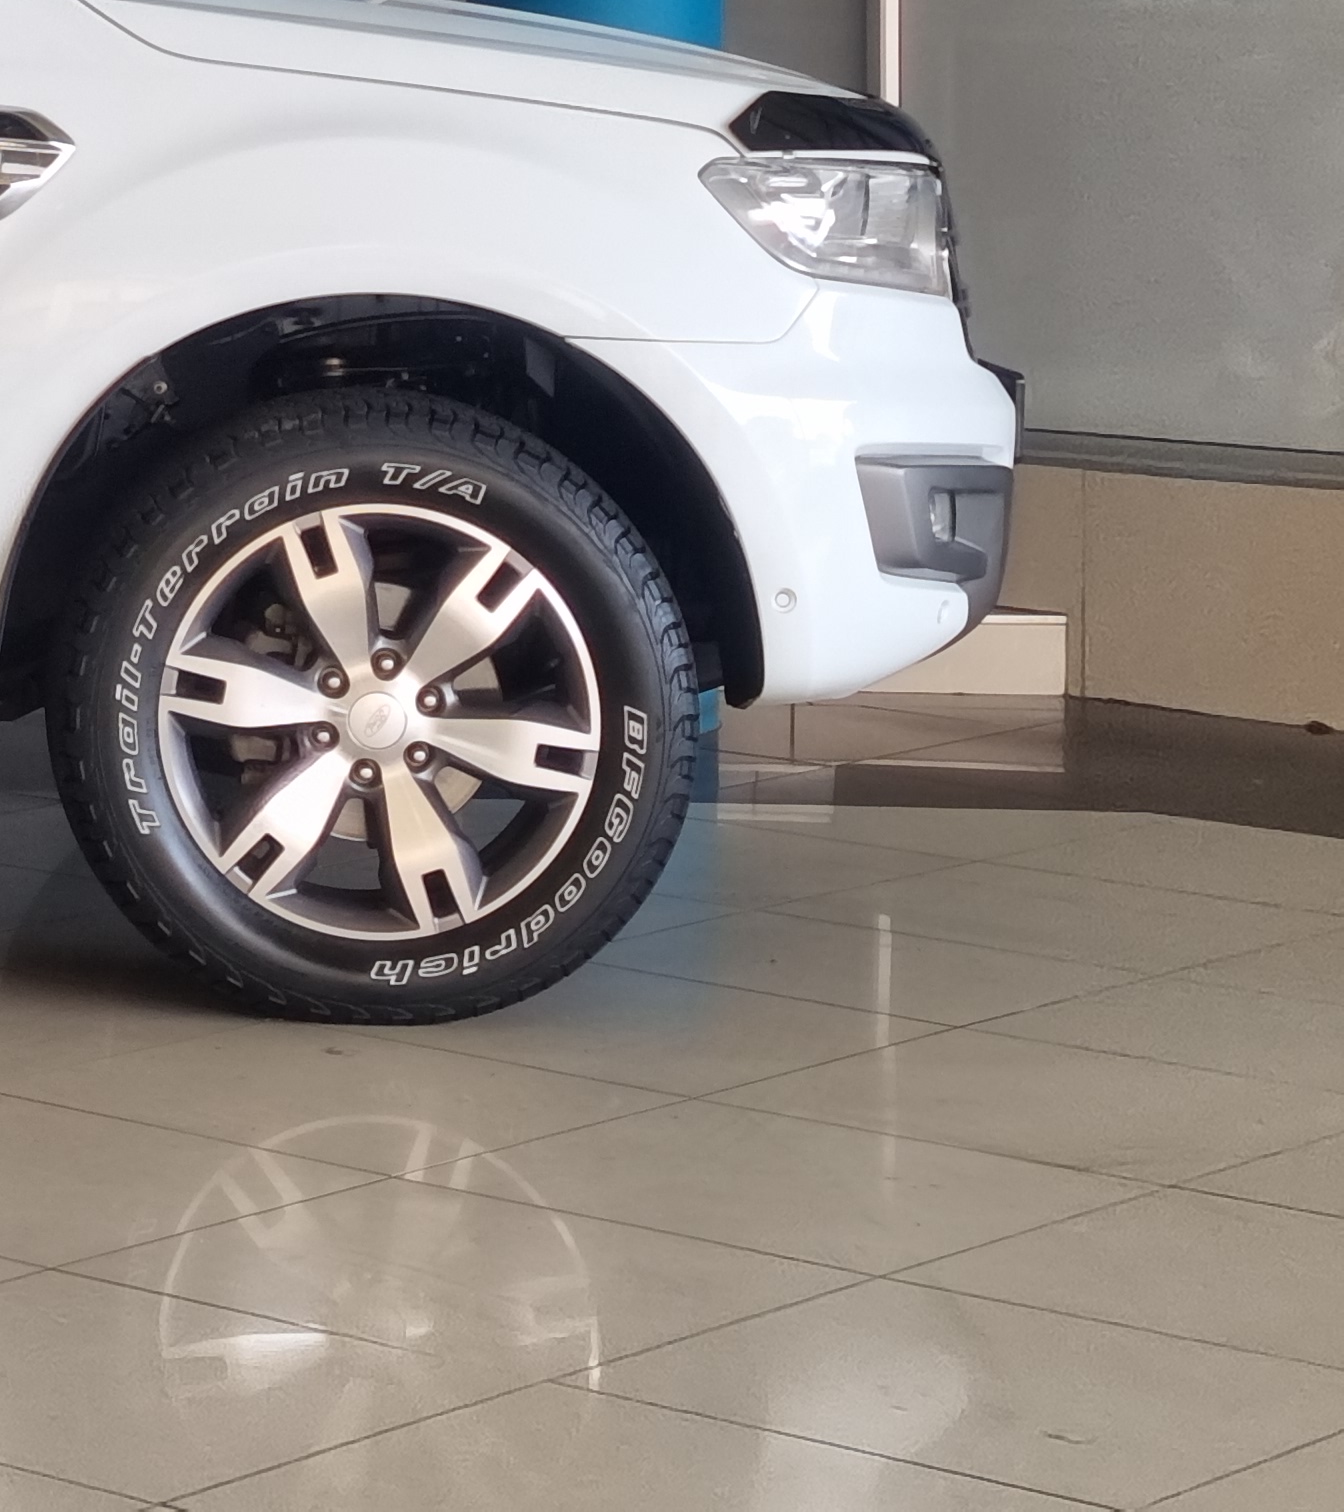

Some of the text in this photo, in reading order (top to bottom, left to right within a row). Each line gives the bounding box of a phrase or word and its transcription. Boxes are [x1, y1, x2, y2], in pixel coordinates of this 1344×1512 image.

[114, 461, 488, 836] Trail-Terrain T/A
[369, 705, 649, 987] BFGoodrich
